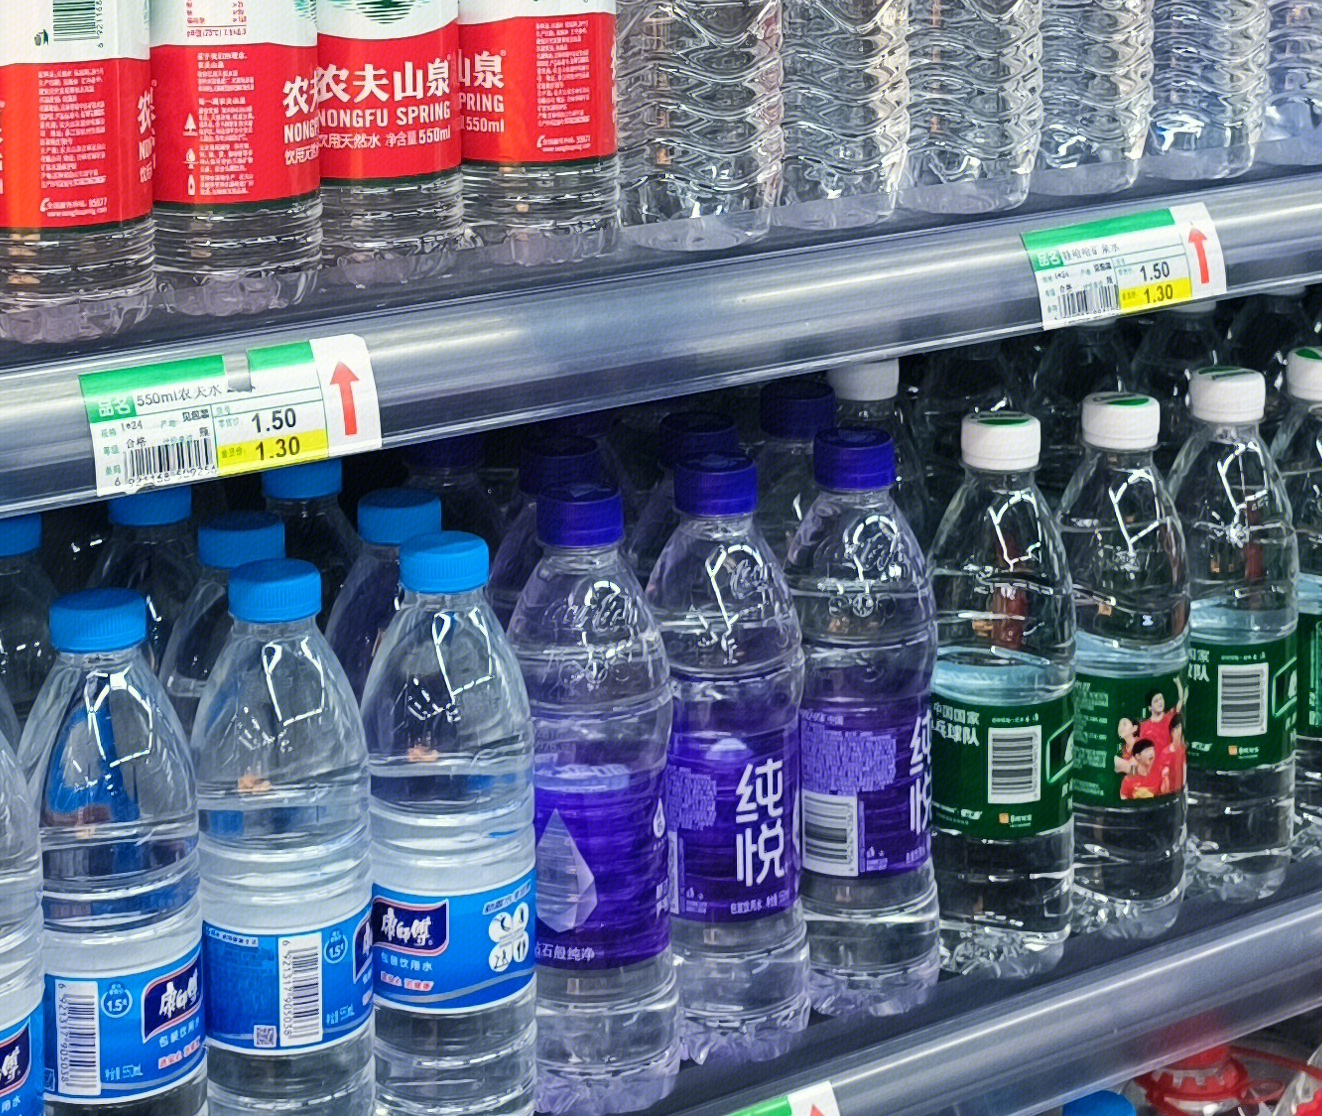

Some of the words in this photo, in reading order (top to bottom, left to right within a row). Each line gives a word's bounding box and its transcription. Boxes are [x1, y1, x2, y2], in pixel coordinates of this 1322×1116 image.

[314, 58, 450, 103] 农夫山泉
[318, 108, 388, 128] NONGFU
[396, 102, 450, 126] SPRING
[1139, 261, 1170, 282] 1.50
[1144, 284, 1174, 304] 1.30
[98, 396, 131, 417] 品名
[251, 407, 297, 433] 1.50
[255, 436, 300, 461] 1.30
[736, 758, 785, 887] 纯悦
[381, 907, 432, 946] 康师傅
